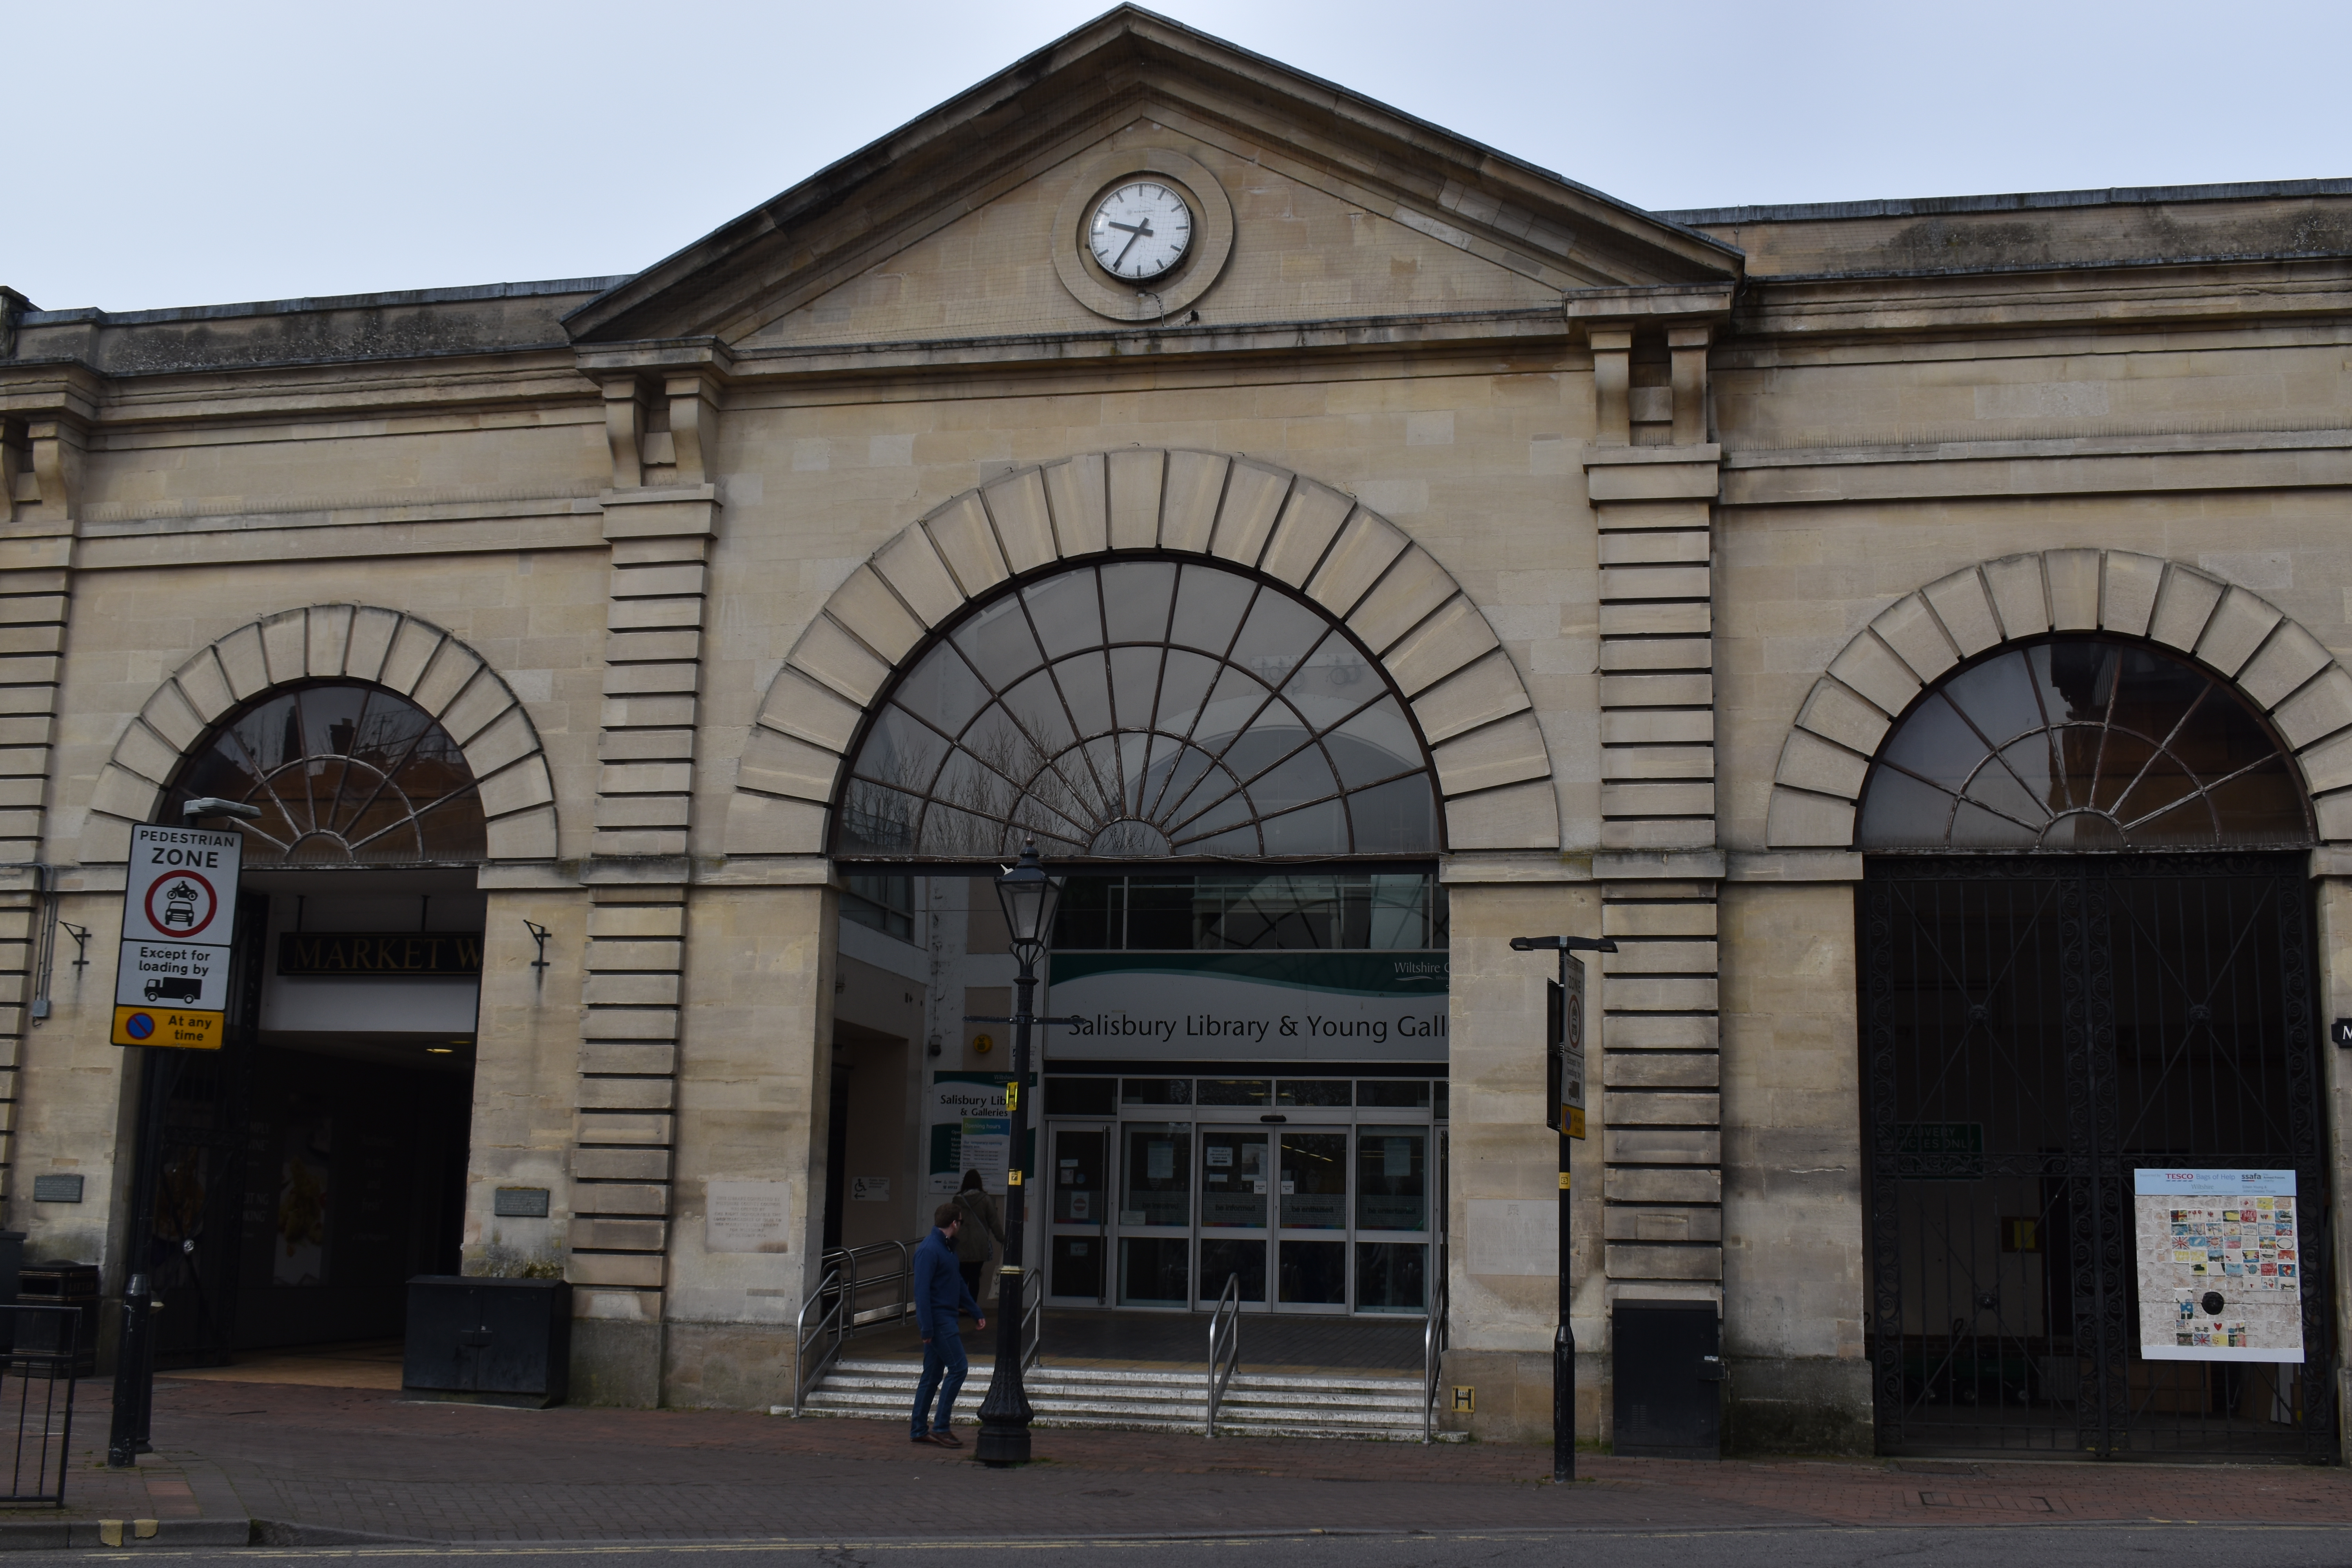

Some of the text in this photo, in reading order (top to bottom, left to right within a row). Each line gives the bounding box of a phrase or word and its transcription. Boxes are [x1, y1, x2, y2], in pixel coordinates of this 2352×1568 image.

[140, 830, 234, 847] PEDESTRIAN
[151, 848, 219, 868] ZONE
[140, 947, 211, 962] Except for
[292, 938, 480, 969] MARKET W
[139, 960, 209, 976] loading by
[1394, 962, 1440, 973] Wiltshire
[1568, 975, 1581, 993] ZONE
[169, 1015, 212, 1029] At any
[1069, 1014, 1449, 1043] Salisbury Library & Young Gall
[174, 1029, 204, 1041] time
[2343, 1026, 2352, 1040] M
[940, 1095, 1006, 1107] Salisbury Lib
[971, 1108, 1008, 1116] Galleries
[69, 1282, 94, 1292] LITTER
[1455, 1388, 1471, 1409] H
